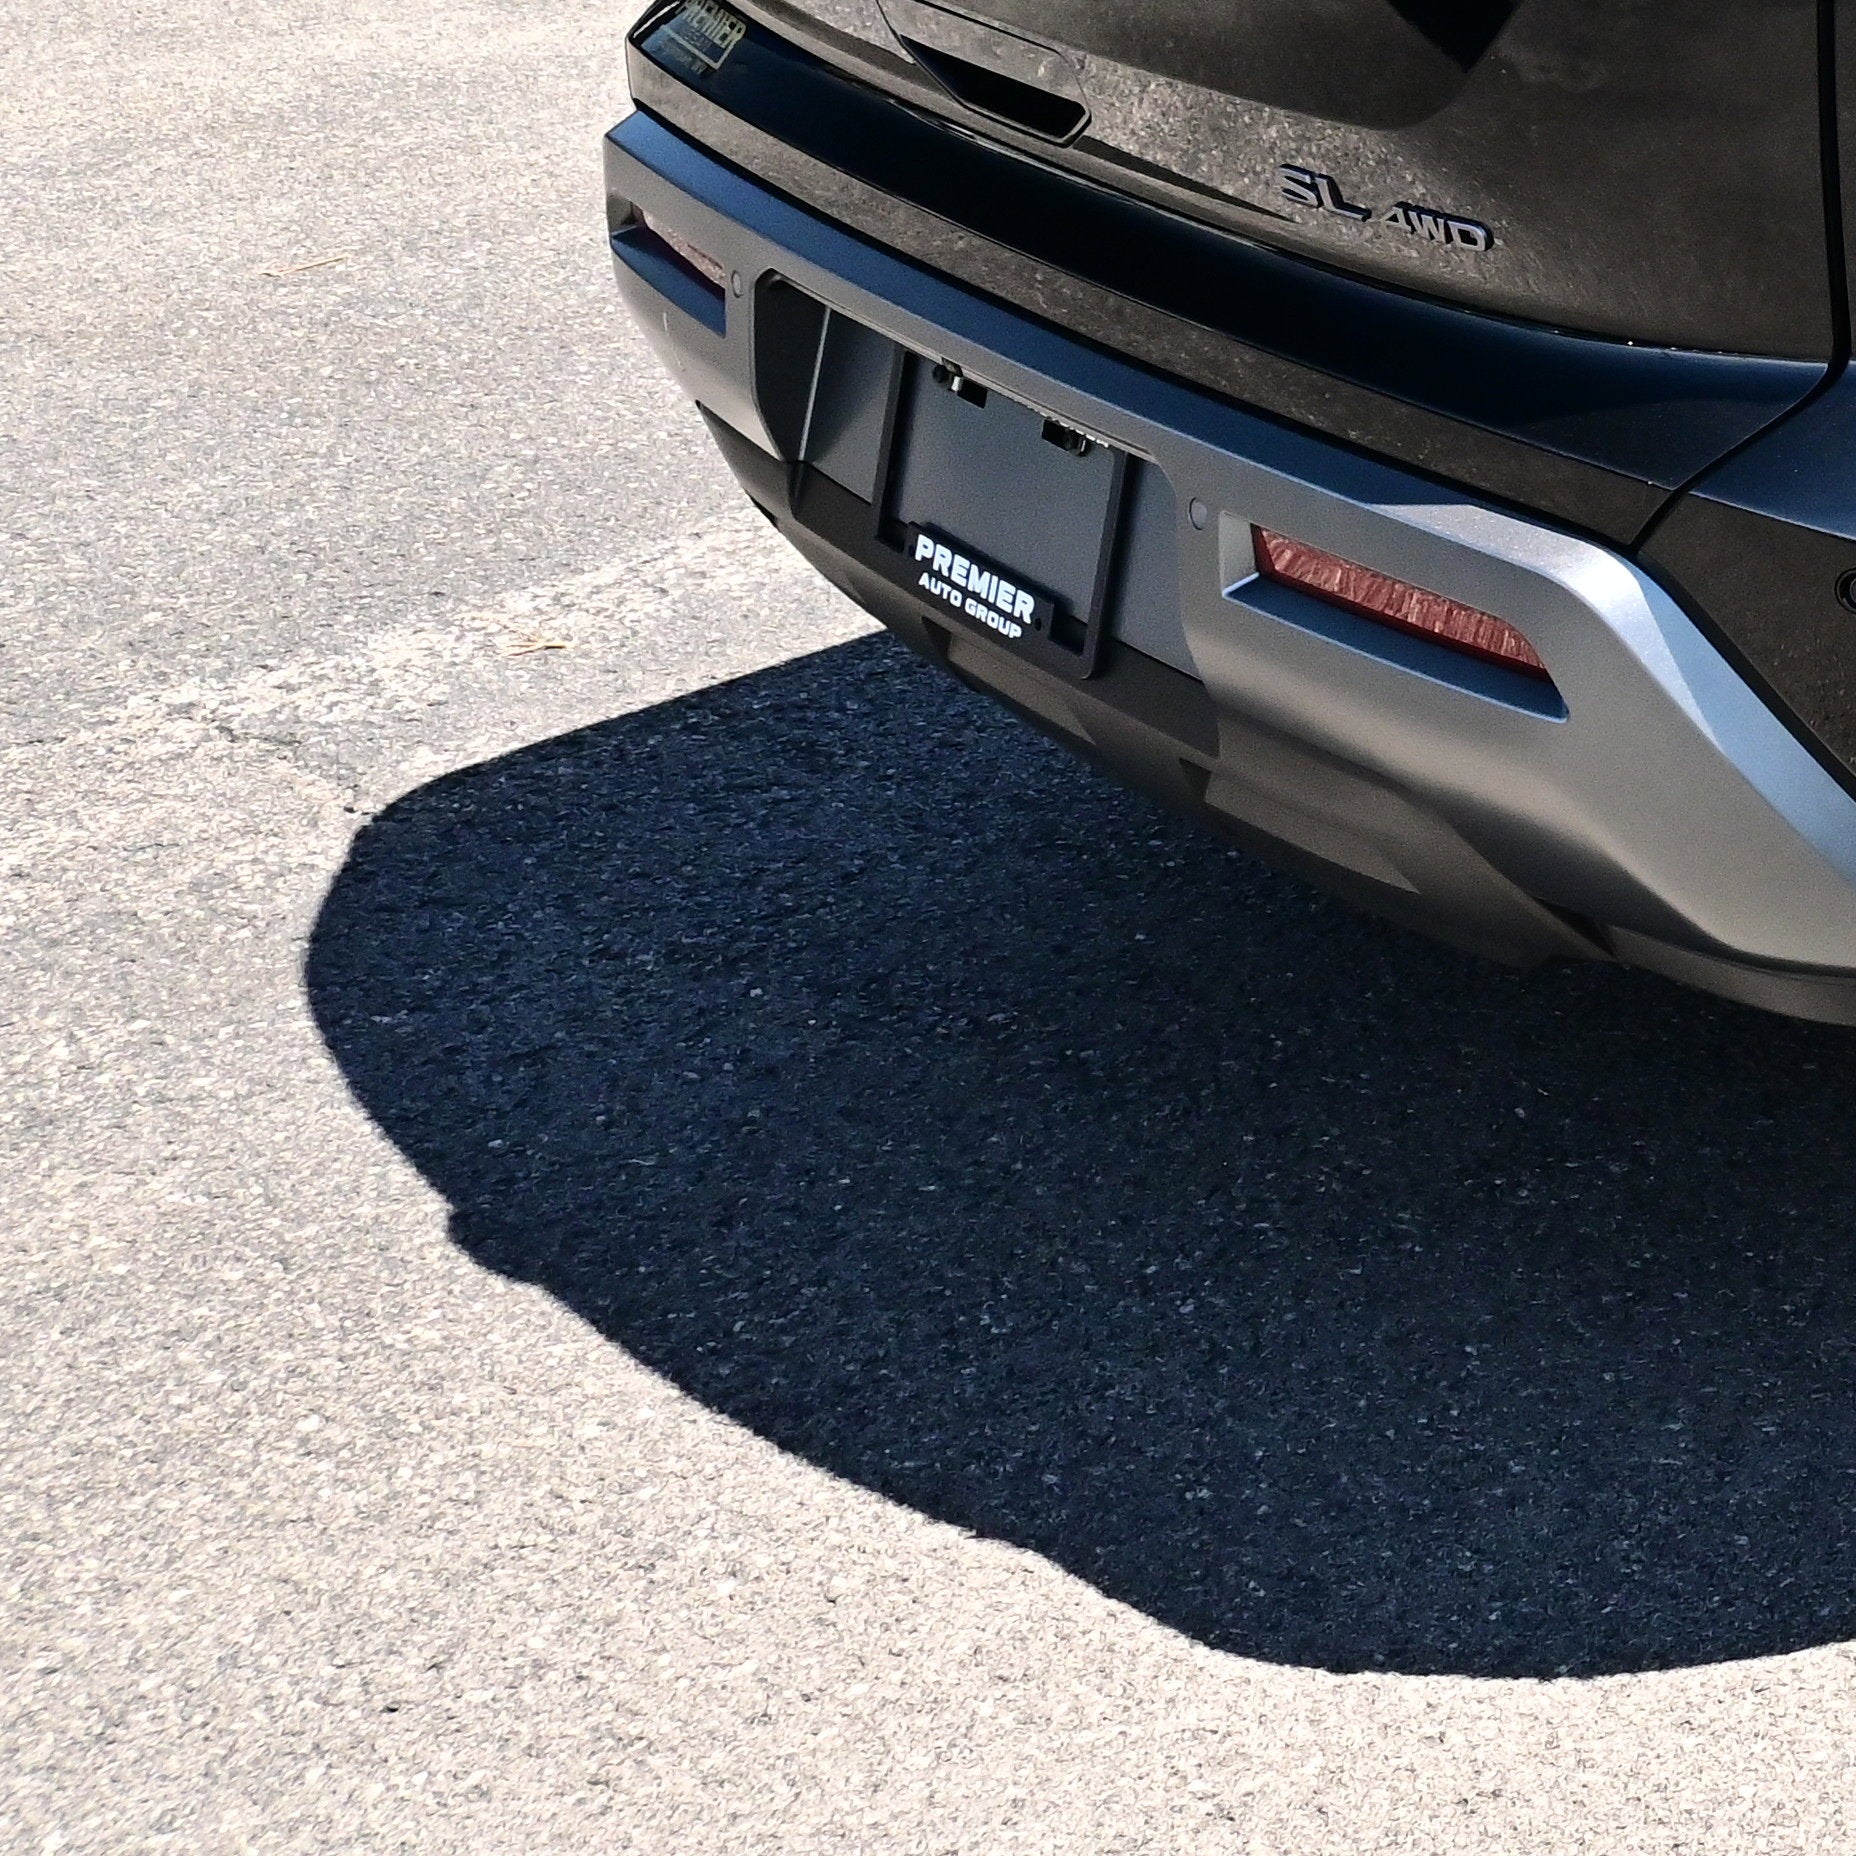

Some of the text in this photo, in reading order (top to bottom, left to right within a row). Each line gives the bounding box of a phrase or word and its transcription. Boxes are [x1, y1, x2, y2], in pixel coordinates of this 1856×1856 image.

[1277, 163, 1495, 252] SL AWD
[914, 533, 1036, 625] PREMIER
[918, 571, 1022, 639] AUTO GROUP
